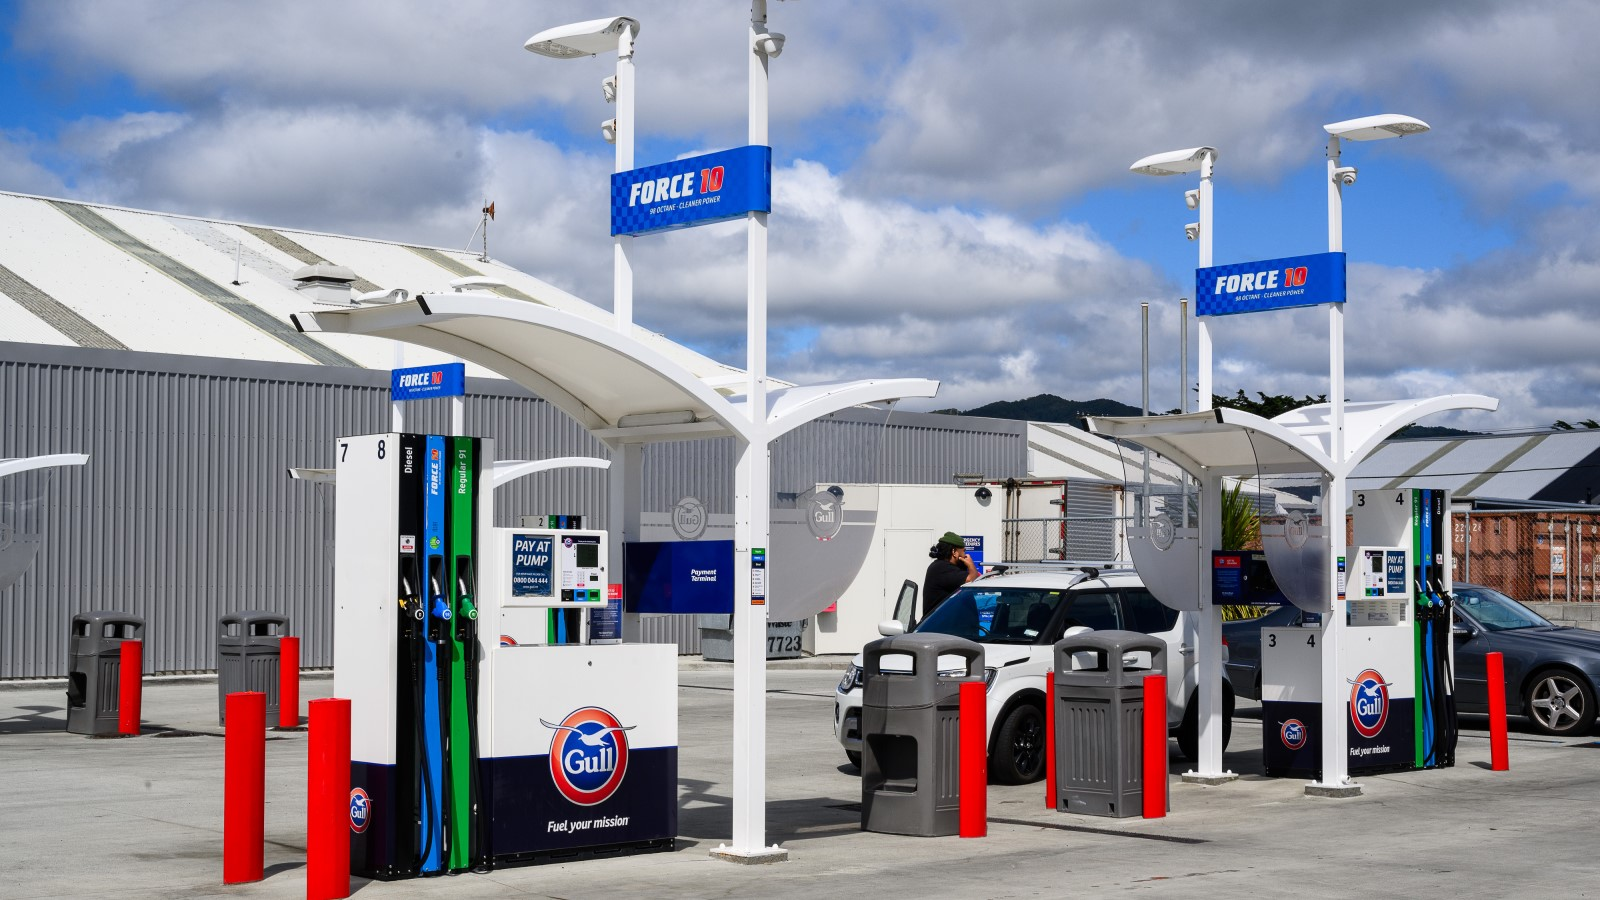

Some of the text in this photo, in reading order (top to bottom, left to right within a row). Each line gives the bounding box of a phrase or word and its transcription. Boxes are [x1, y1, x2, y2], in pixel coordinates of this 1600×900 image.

[629, 166, 724, 206] FORCE 10
[657, 204, 676, 213] OCTANE
[679, 199, 702, 209] CLEANER
[702, 196, 720, 205] POWER
[1215, 267, 1308, 294] FORCE 10
[400, 371, 442, 387] FORCE 10
[341, 444, 348, 462] 7
[378, 440, 385, 459] 8
[432, 449, 438, 460] 10
[458, 450, 467, 494] Regular 91
[1358, 494, 1365, 506] 3
[1396, 493, 1404, 505] 4
[521, 519, 524, 527] 1
[539, 518, 543, 526] 2
[815, 511, 834, 523] Gull
[515, 541, 550, 552] PAY AT
[516, 555, 548, 566] PUMP
[1388, 556, 1404, 564] PAY AT
[1388, 565, 1403, 573] PUMP
[768, 636, 801, 652] 7723
[1269, 634, 1276, 647] 3
[1307, 634, 1315, 647] 4
[1358, 698, 1382, 716] Gull
[1286, 731, 1301, 740] Gull
[1350, 745, 1390, 757] Fuel your mission
[565, 747, 613, 774] Gull
[351, 806, 366, 818] Gull
[548, 815, 629, 833] Fuel your mission
